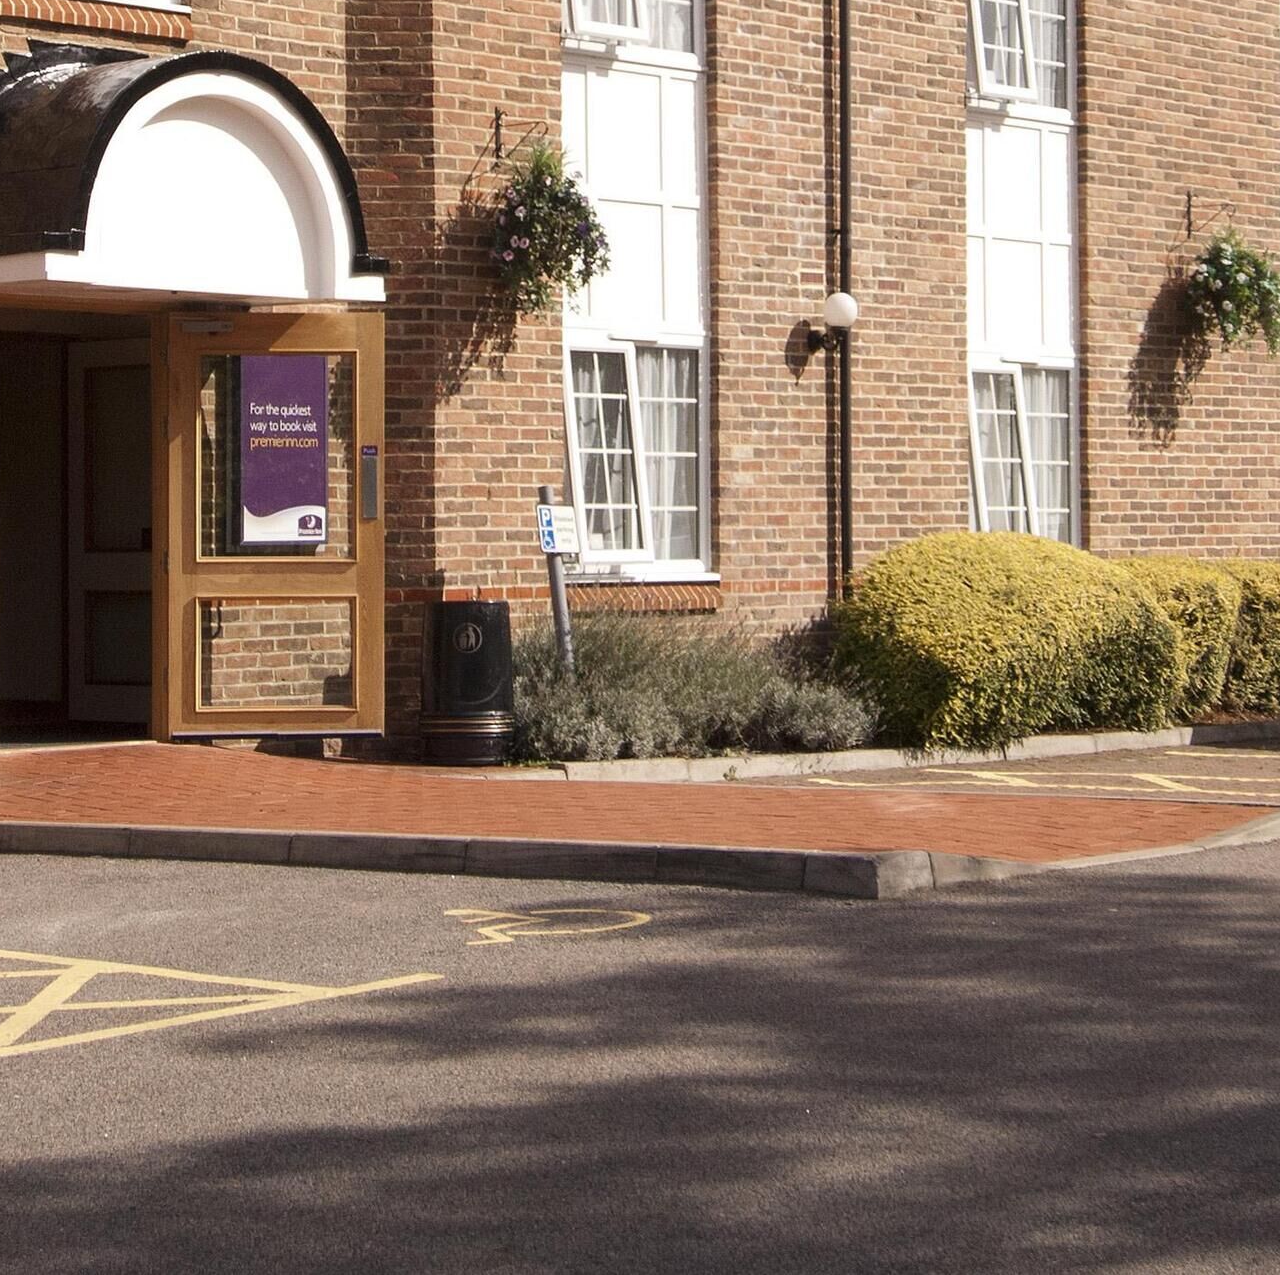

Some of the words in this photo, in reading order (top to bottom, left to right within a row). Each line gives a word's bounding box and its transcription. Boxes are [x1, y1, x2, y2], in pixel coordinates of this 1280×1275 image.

[249, 402, 264, 415] For
[265, 403, 280, 415] the
[280, 404, 312, 418] quickest
[249, 422, 267, 434] way
[269, 420, 279, 432] to
[280, 420, 302, 432] book
[302, 420, 318, 433] visit
[249, 434, 319, 451] premierinn.com
